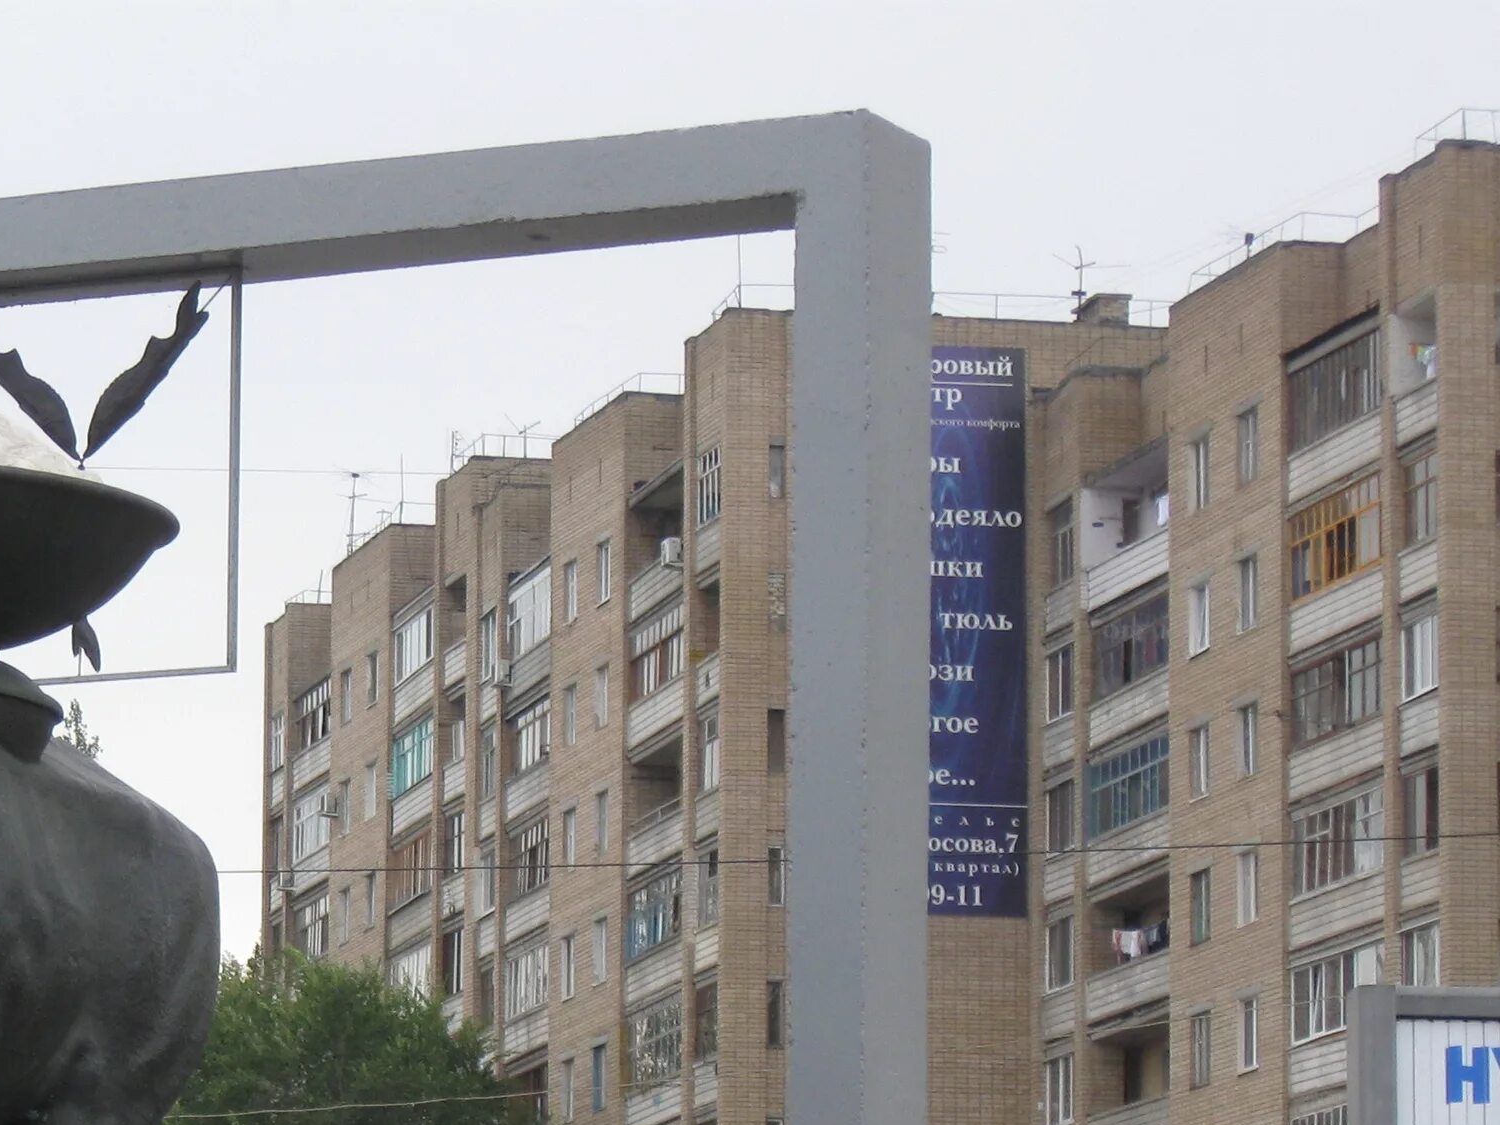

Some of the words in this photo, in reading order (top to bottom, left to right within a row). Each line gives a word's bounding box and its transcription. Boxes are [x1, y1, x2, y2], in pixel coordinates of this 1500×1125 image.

[967, 418, 1021, 431] комфорта
[930, 509, 1022, 528] деяло
[940, 613, 1013, 631] тюль
[928, 884, 983, 906] 9-11
